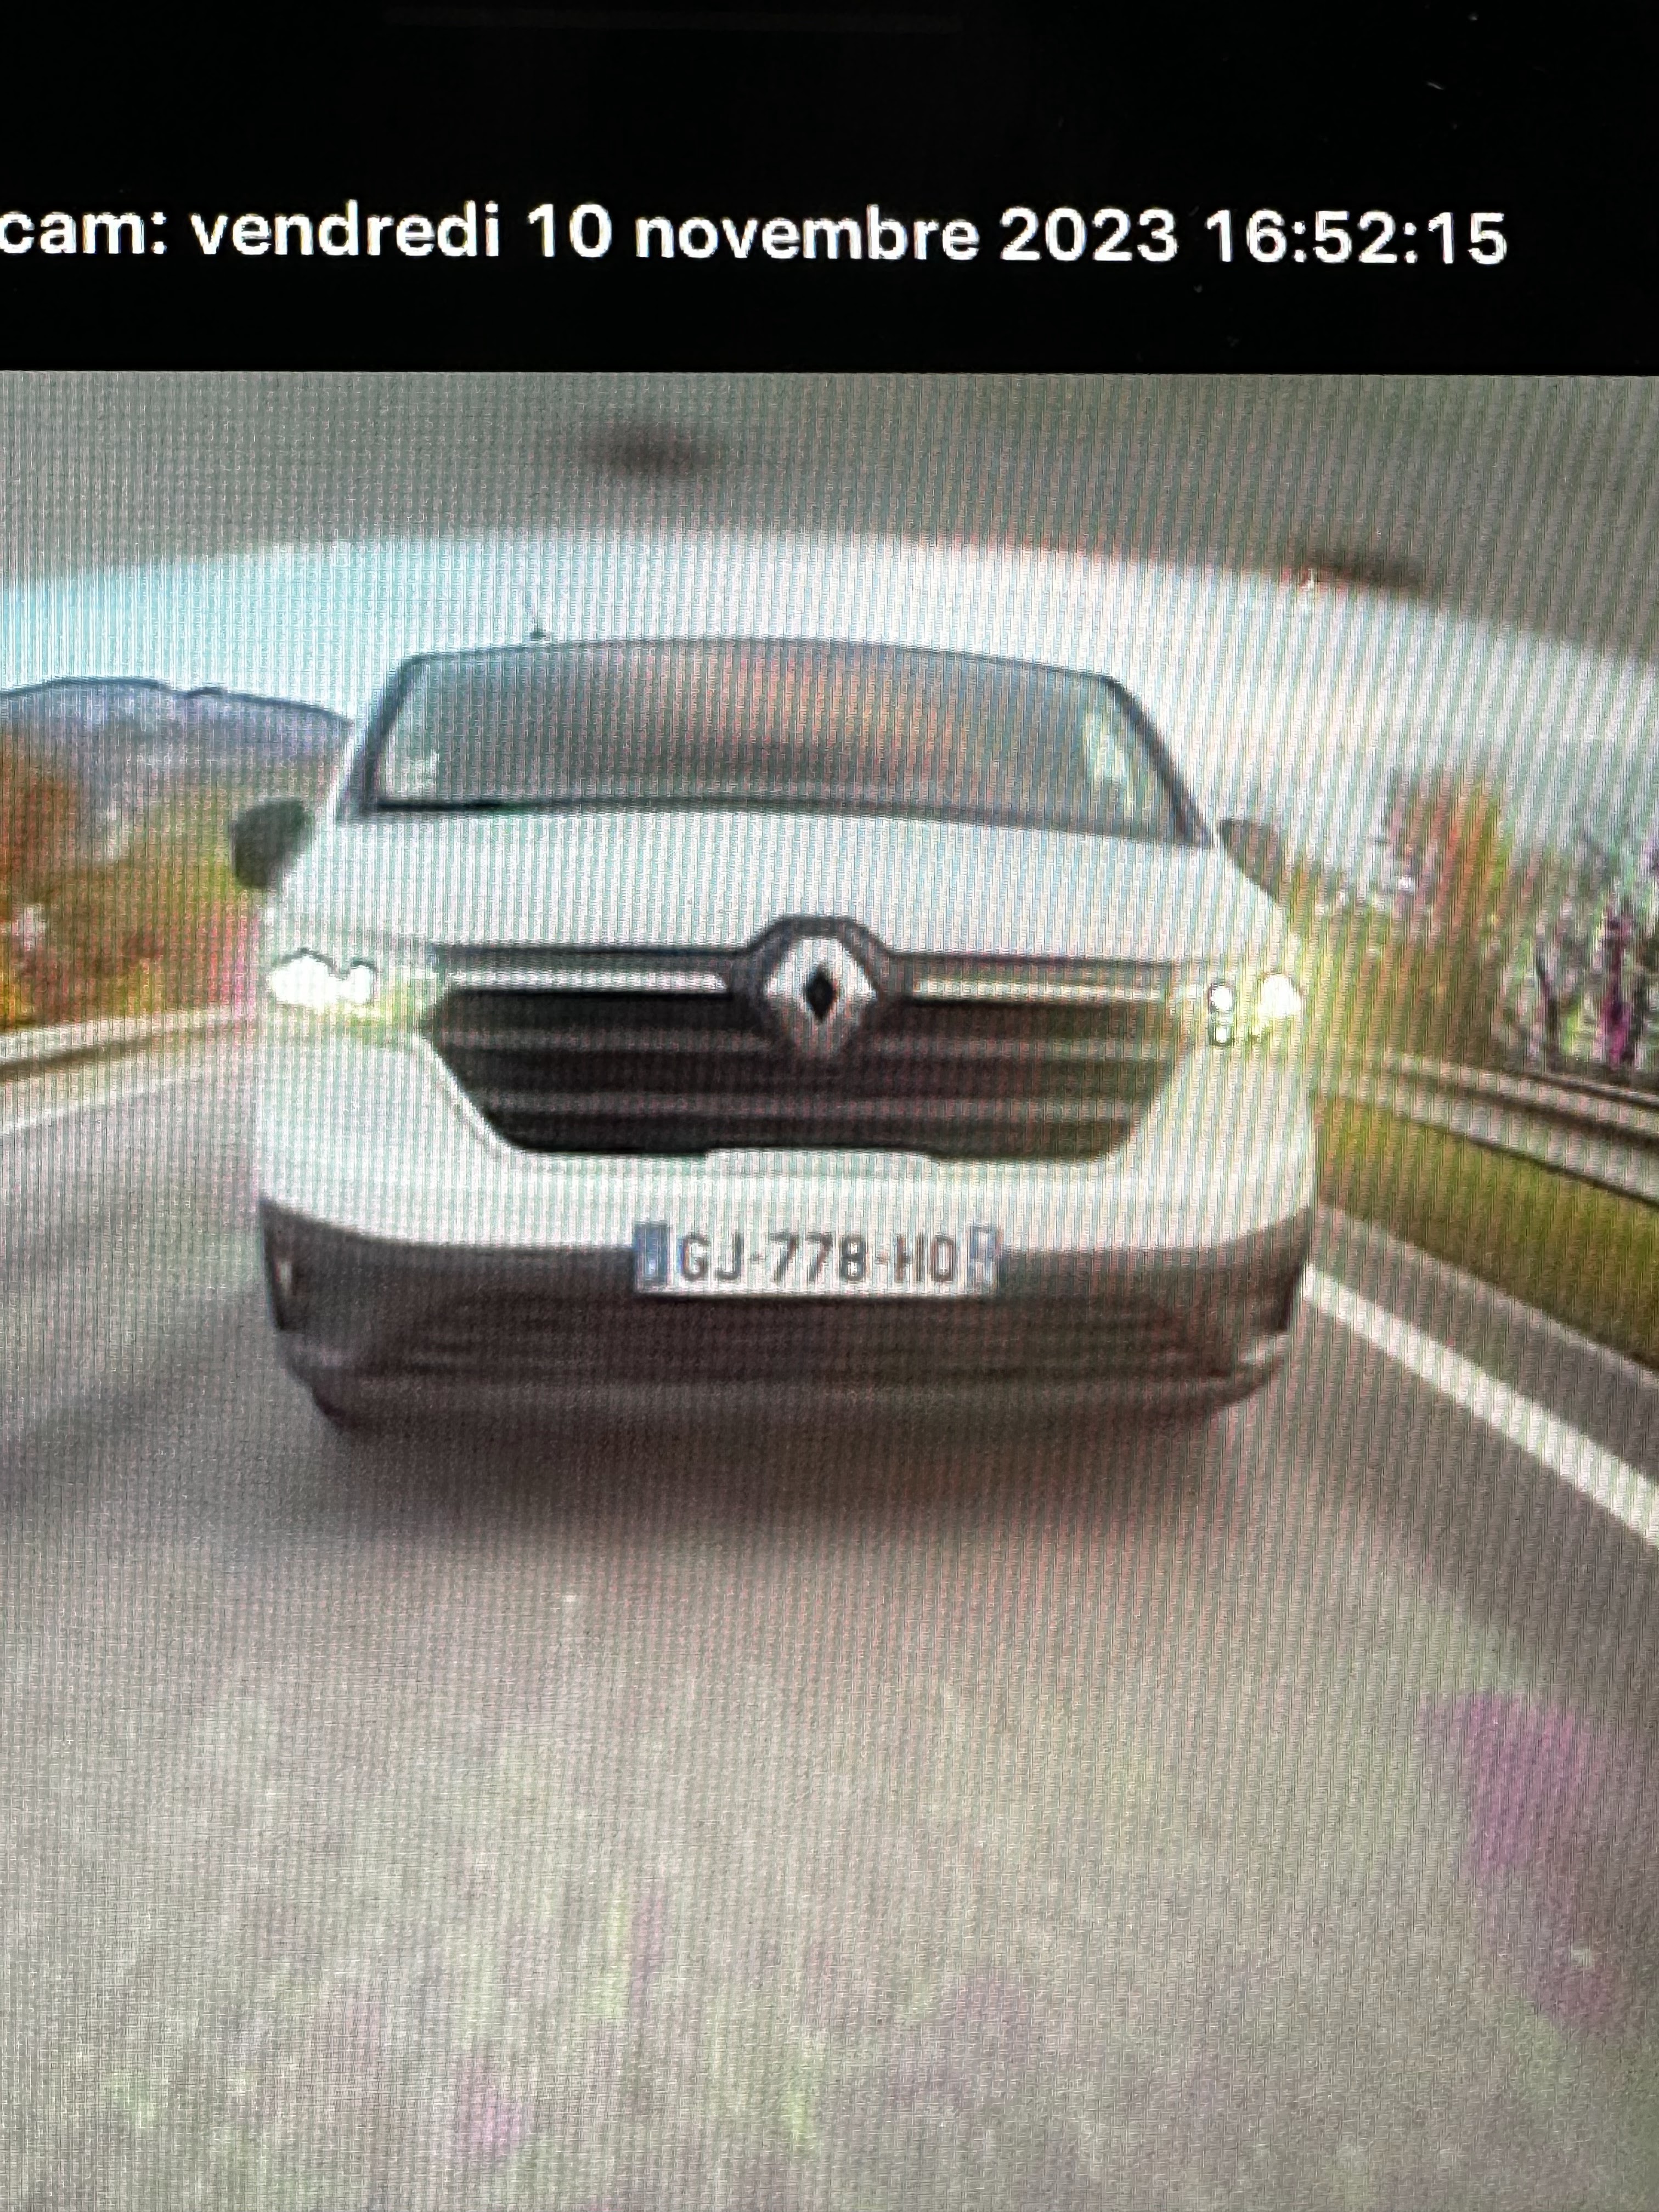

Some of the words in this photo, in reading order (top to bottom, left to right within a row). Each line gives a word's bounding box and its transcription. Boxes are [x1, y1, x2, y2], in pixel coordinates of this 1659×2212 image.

[190, 199, 499, 257] vendredi
[528, 204, 612, 257] 10
[635, 204, 979, 260] novembre
[1000, 206, 1178, 262] 2023
[1206, 209, 1507, 264] 16:52:15
